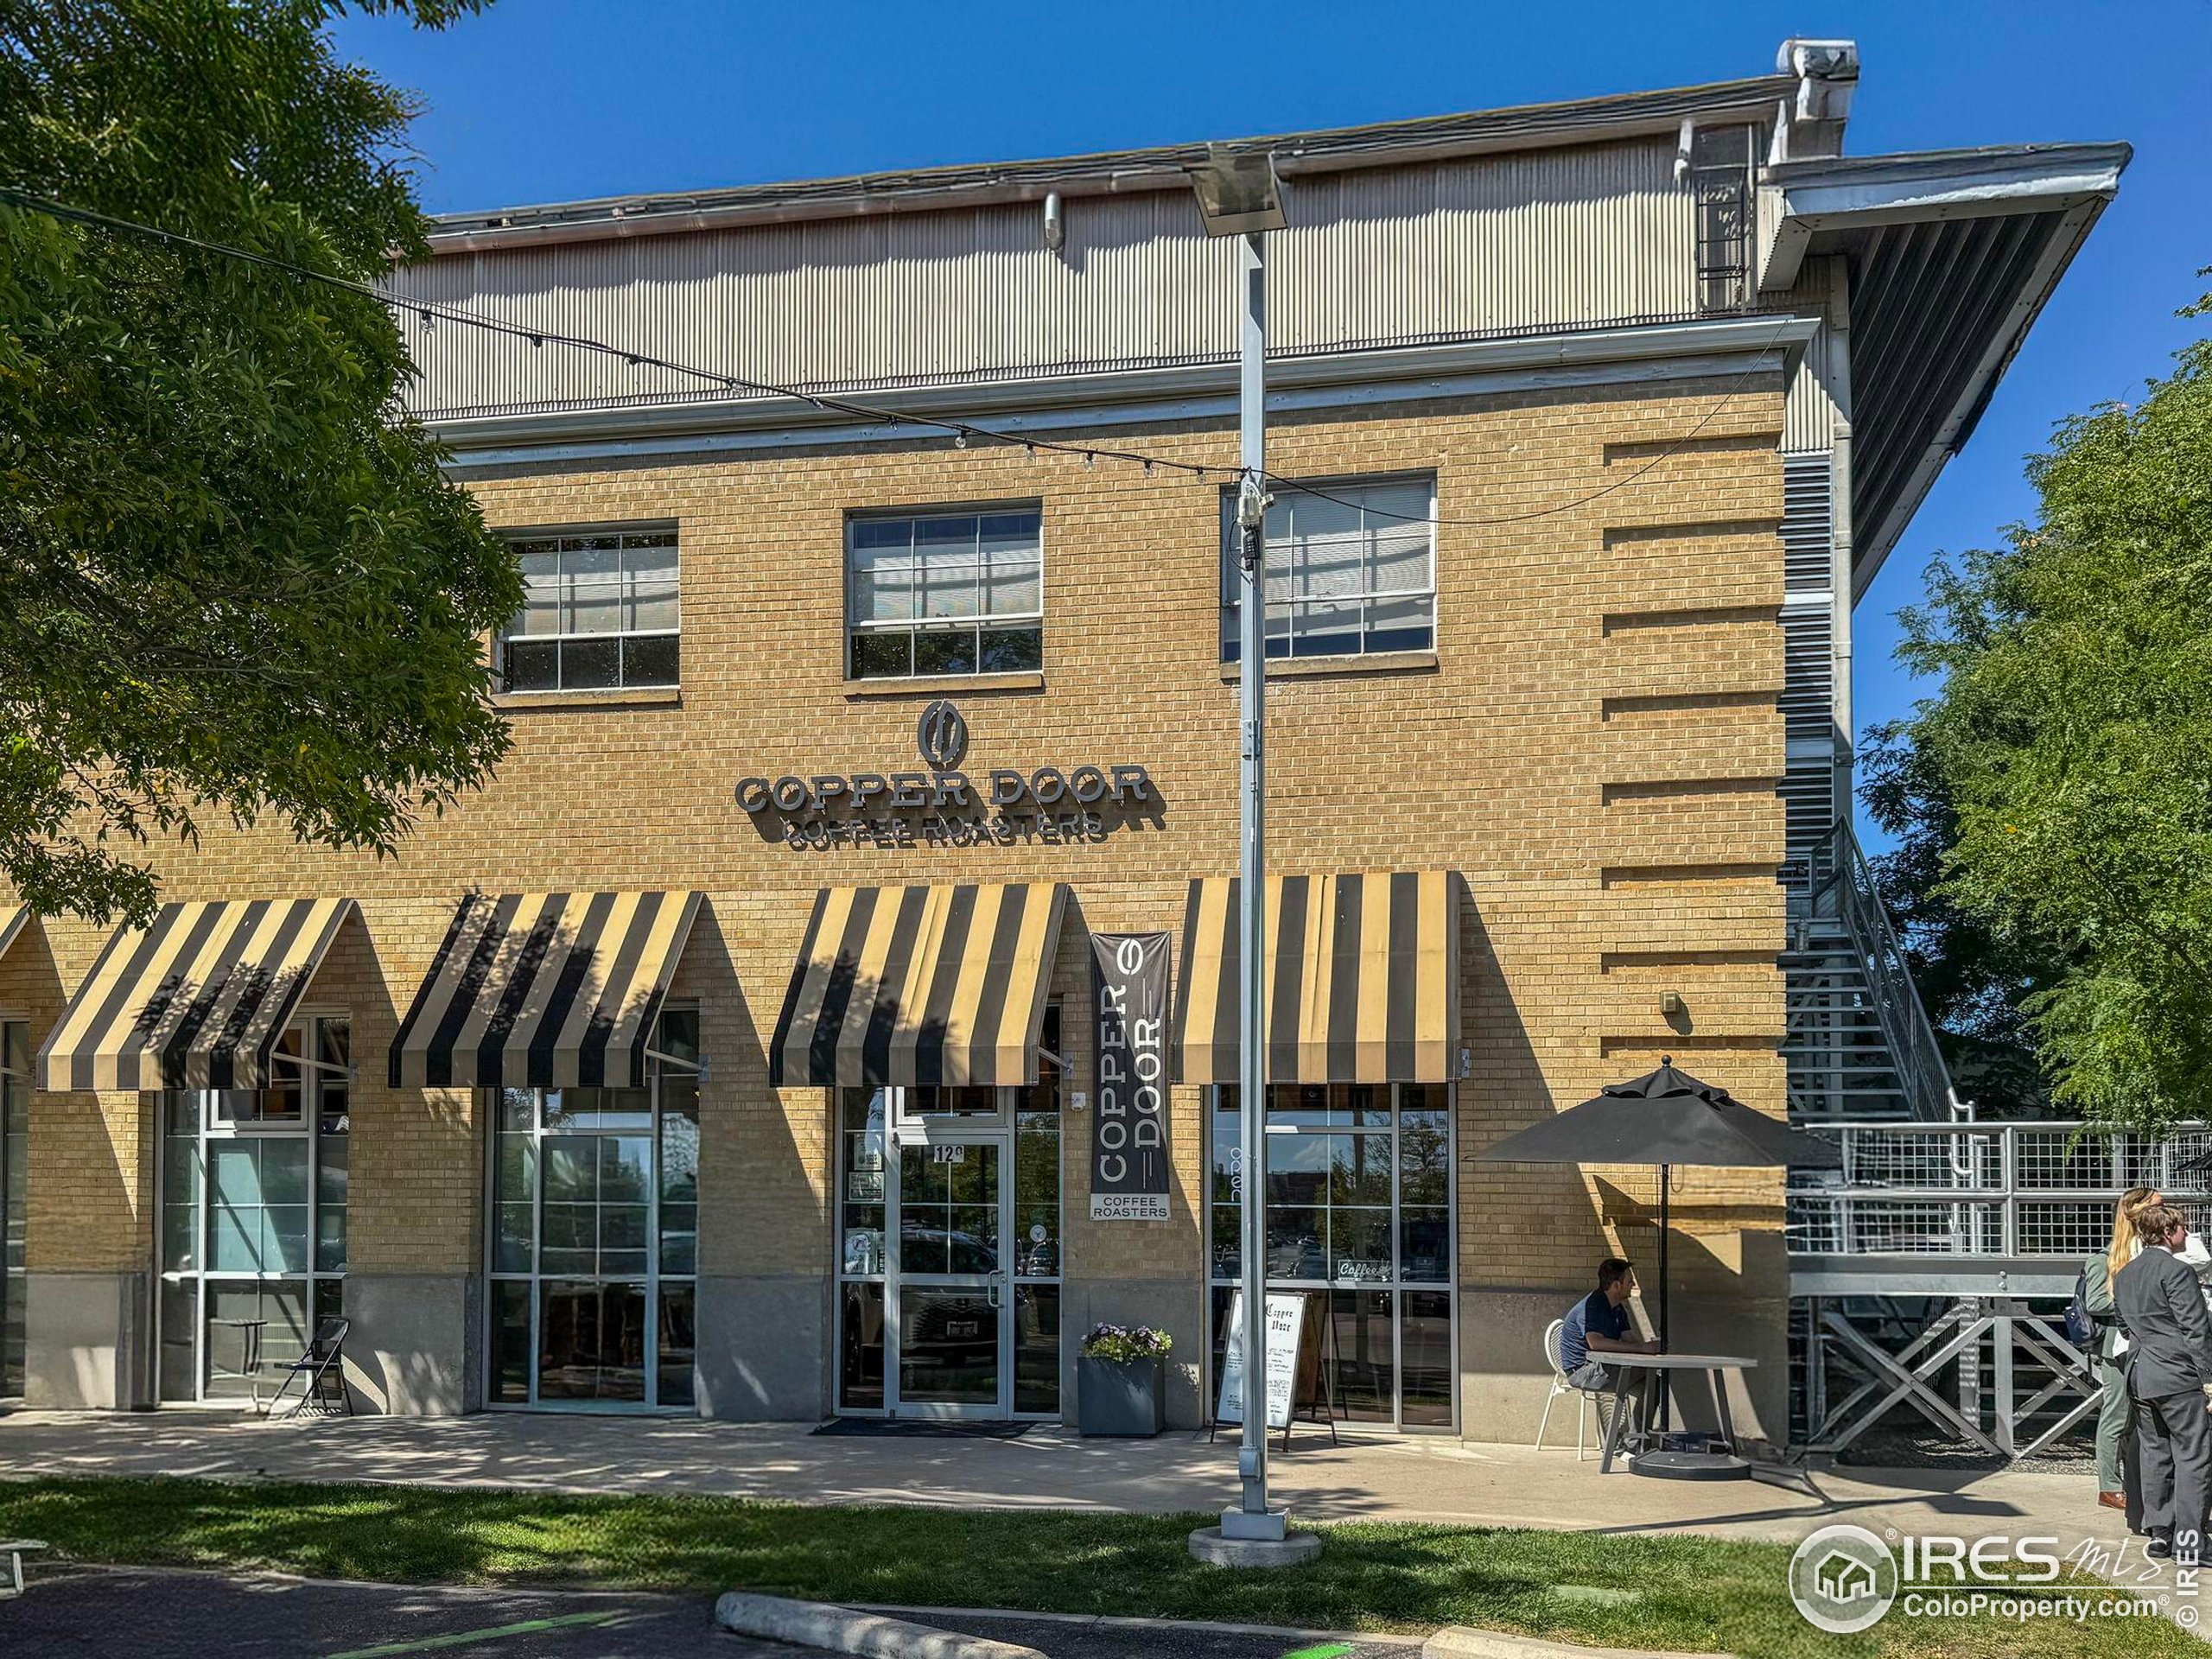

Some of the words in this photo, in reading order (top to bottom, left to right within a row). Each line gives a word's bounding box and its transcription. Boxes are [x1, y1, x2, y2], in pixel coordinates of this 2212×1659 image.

[735, 771, 969, 812] COPPER
[988, 765, 1149, 805] DOOR
[782, 817, 911, 842] COFFEE
[922, 810, 1103, 839] ROASTERS
[1100, 984, 1127, 1182] COPPER
[1134, 1018, 1161, 1148] DOOR
[1093, 1208, 1167, 1217] ROASTERS
[1103, 1197, 1158, 1206] COFFEE
